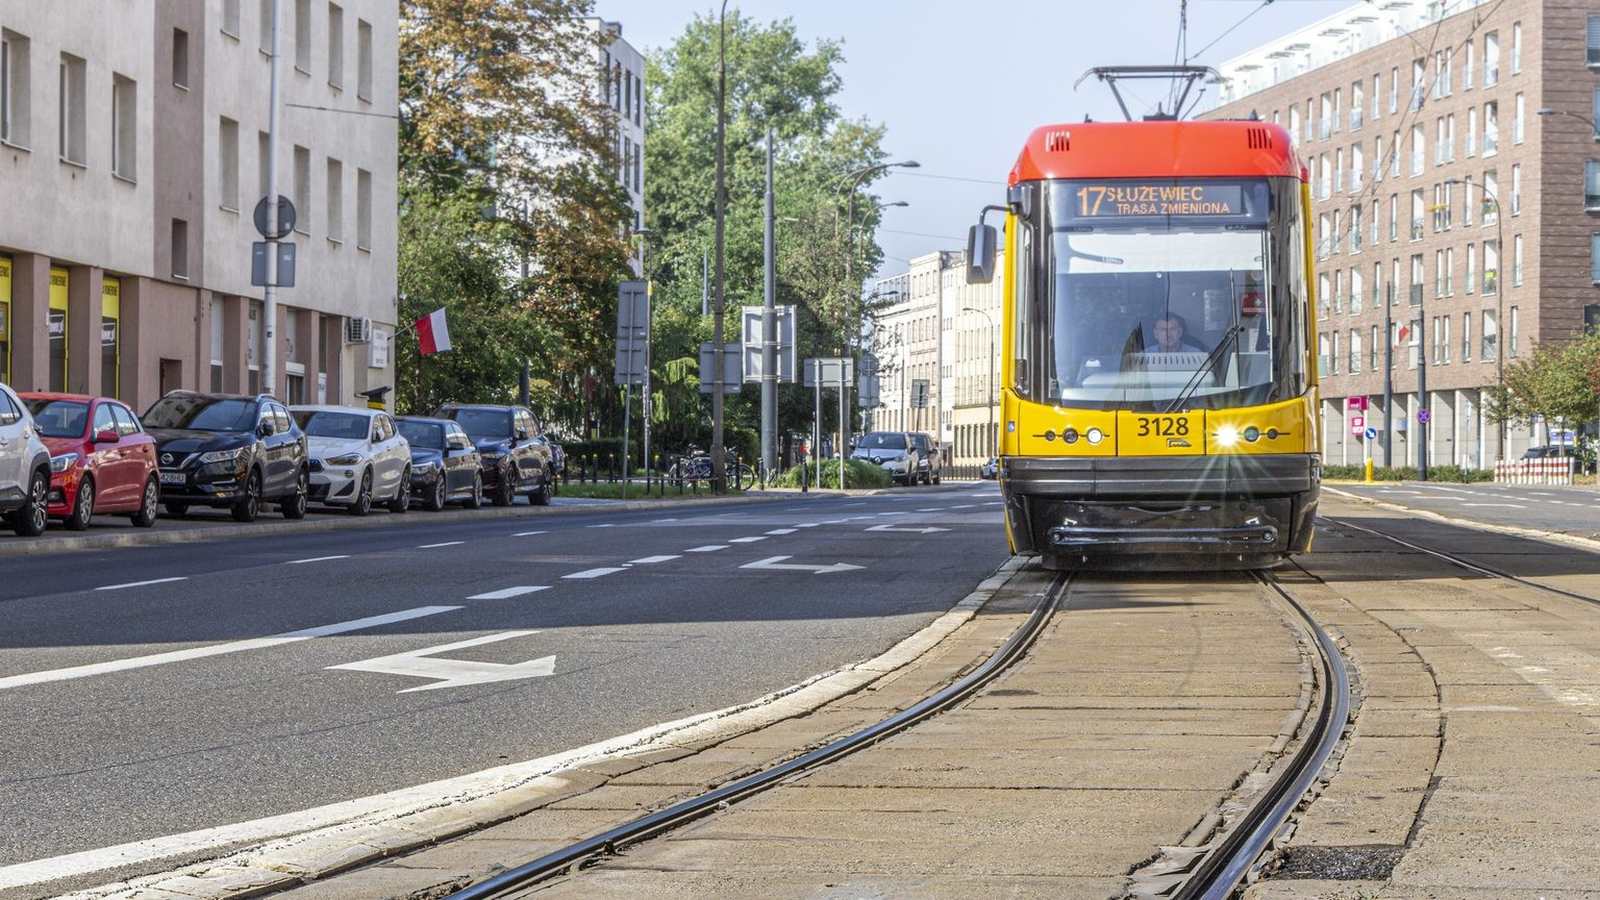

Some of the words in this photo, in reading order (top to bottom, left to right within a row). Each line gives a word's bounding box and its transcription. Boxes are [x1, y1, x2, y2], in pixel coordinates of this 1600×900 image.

[1077, 185, 1106, 216] 17
[1107, 185, 1202, 201] SŁUŻEWIEC
[1117, 203, 1157, 214] TRASA
[1161, 203, 1230, 214] ZMIENIONA
[1138, 417, 1188, 436] 3128
